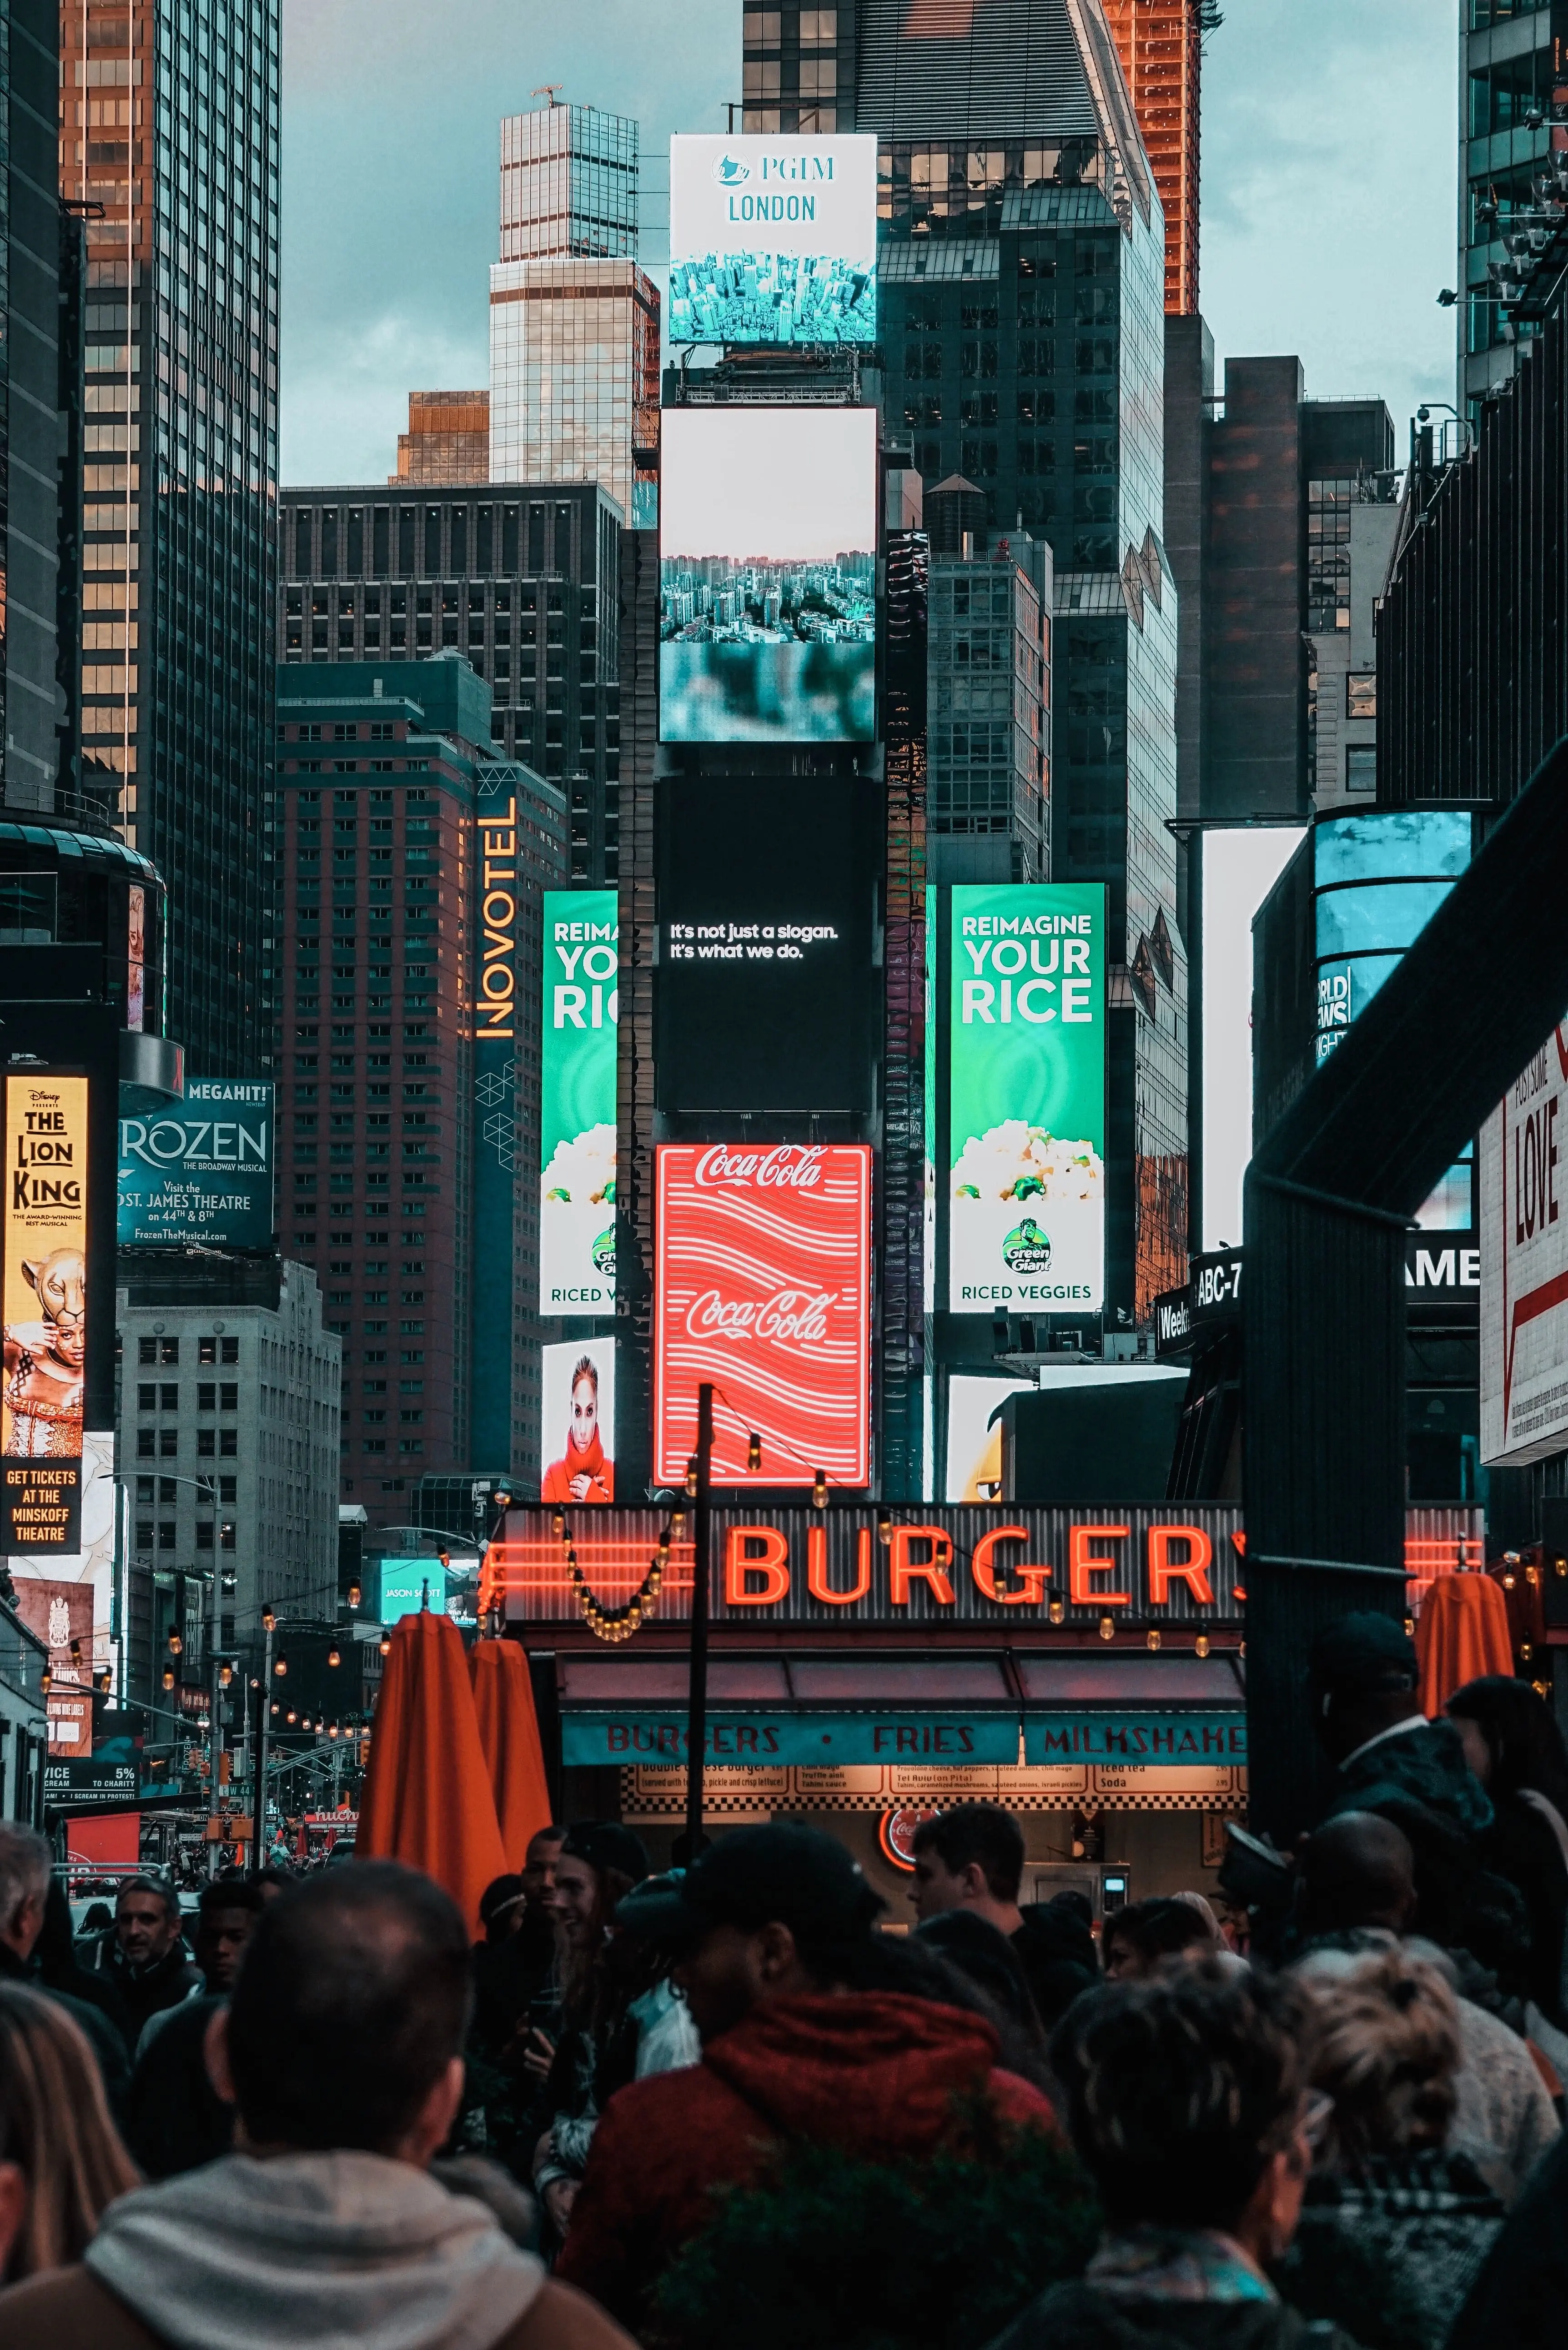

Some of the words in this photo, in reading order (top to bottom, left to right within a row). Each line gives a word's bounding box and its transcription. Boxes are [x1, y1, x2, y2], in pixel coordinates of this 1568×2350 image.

[763, 157, 833, 180] PGIM
[729, 196, 814, 221] LONDON
[476, 797, 517, 1038] NOVOTEL
[962, 915, 1091, 936] REIMAGINE
[671, 924, 694, 939] It's
[698, 925, 725, 939] not
[728, 924, 759, 942] just
[762, 926, 774, 939] a
[778, 924, 838, 943] slogan.
[671, 944, 694, 958] It's
[698, 944, 743, 958] what
[746, 946, 773, 958] we
[777, 944, 803, 958] do.
[963, 939, 1091, 975] YOUR
[962, 979, 1092, 1024] RICE
[1531, 1041, 1548, 1096] SOME
[24, 1112, 65, 1130] THE
[183, 1162, 196, 1170] THE
[198, 1162, 236, 1171] BROADWAY
[238, 1163, 267, 1172] MUSICAL
[695, 1144, 829, 1187] Coca-Cola
[1516, 1094, 1558, 1246] LOVE
[163, 1181, 184, 1193] Visit
[186, 1182, 200, 1193] the
[126, 1193, 142, 1207] ST.
[146, 1194, 189, 1208] JAMES
[192, 1195, 251, 1210] THEATRE
[187, 1210, 196, 1222] &
[135, 1228, 226, 1240] FrozenTheMusical.com
[1006, 1246, 1050, 1260] Green
[1011, 1258, 1050, 1272] Giant
[1198, 1262, 1242, 1306] ABC-7
[552, 1288, 602, 1301] RICED
[962, 1286, 1012, 1299] RICED
[1018, 1285, 1091, 1299] VEGGIES
[687, 1290, 839, 1340] Coca-Cola
[7, 1471, 27, 1485] GET
[30, 1471, 76, 1485] TICKETS
[22, 1490, 36, 1503] AT
[39, 1490, 60, 1503] THE
[12, 1508, 69, 1522] MINSKOFF
[16, 1526, 65, 1541] THEATRE
[386, 1589, 412, 1598] JASON
[71, 1704, 84, 1716] LABELS
[874, 1726, 975, 1753] FRIES
[116, 1768, 135, 1779] 5%
[709, 1778, 728, 1788] pickle
[729, 1778, 740, 1786] and
[742, 1778, 757, 1788] crisp
[1101, 1778, 1126, 1787] Soda
[230, 1786, 236, 1795] W
[241, 1786, 250, 1795] 44
